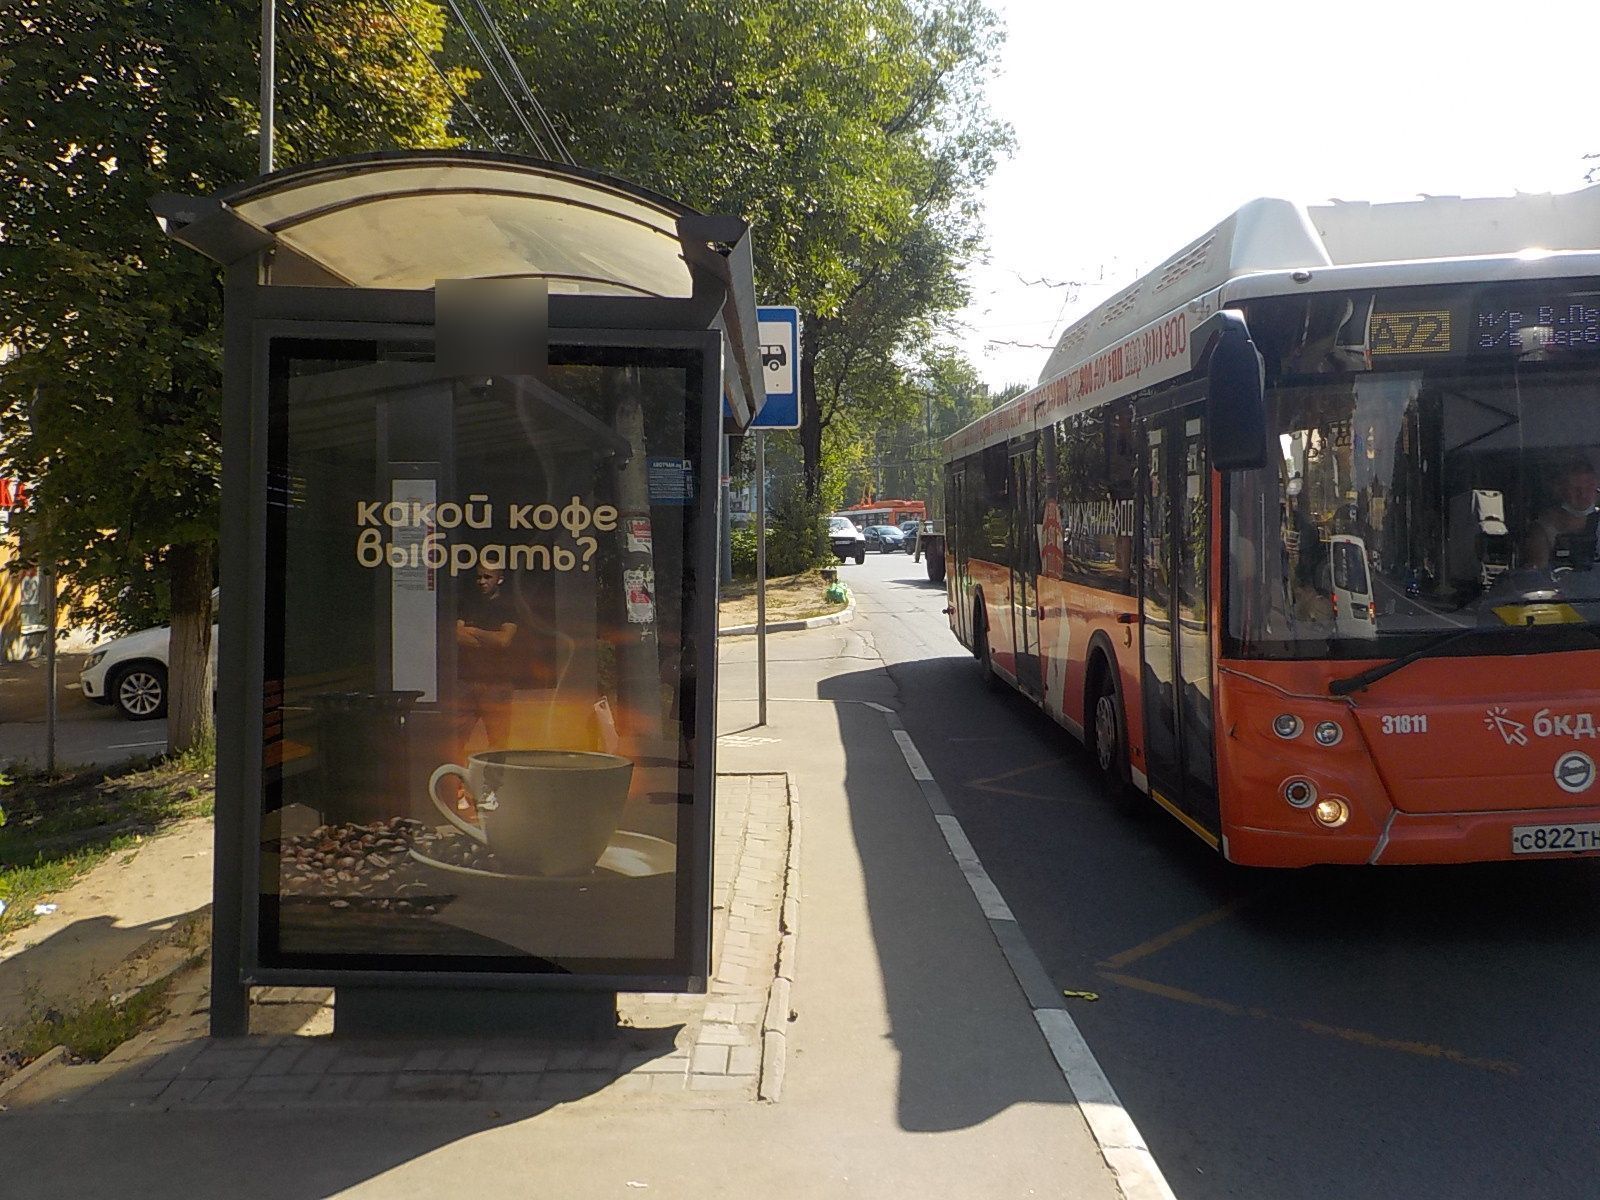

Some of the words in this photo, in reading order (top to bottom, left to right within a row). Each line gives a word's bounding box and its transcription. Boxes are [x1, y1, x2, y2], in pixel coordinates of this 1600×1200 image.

[1164, 312, 1187, 360] 800
[1371, 315, 1444, 349] А72
[1478, 310, 1523, 328] м/р
[1479, 330, 1524, 347] а/в
[357, 494, 493, 529] какой
[509, 495, 618, 538] кофе
[356, 528, 598, 577] выбрать?
[1381, 714, 1427, 734] 31811
